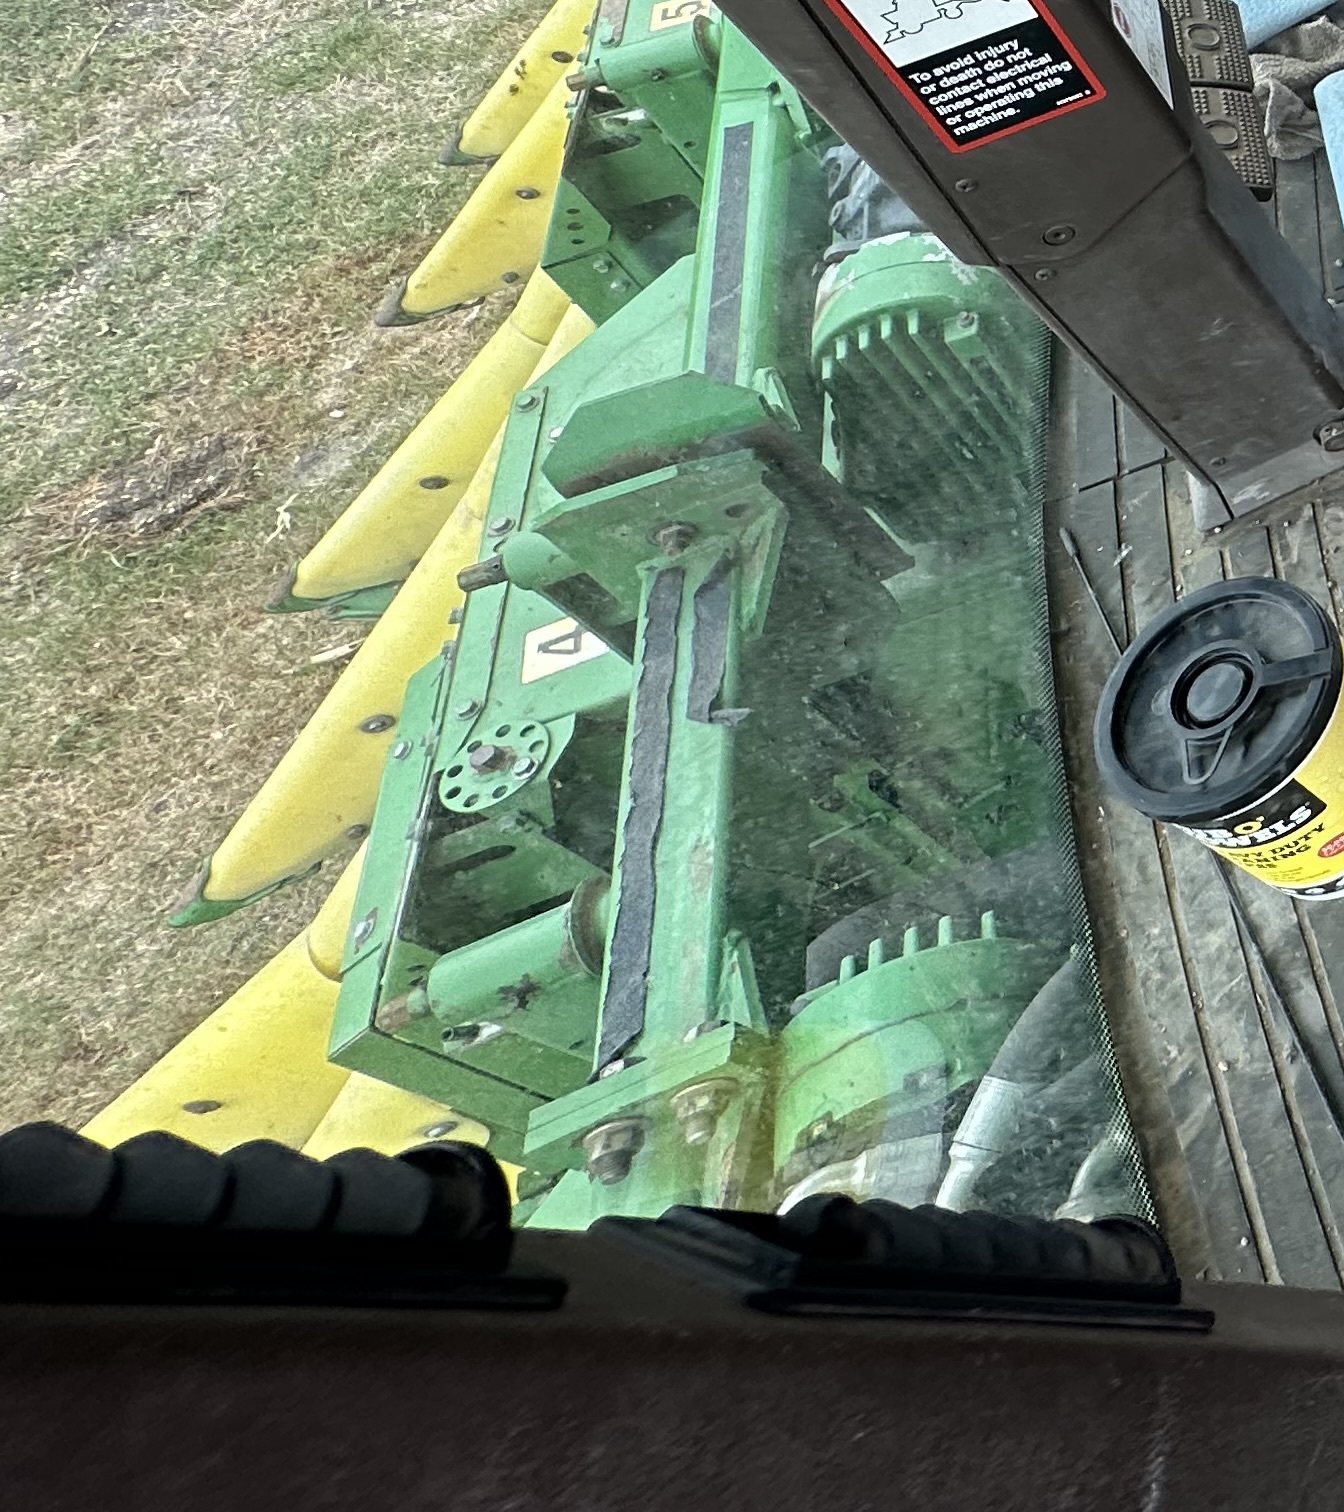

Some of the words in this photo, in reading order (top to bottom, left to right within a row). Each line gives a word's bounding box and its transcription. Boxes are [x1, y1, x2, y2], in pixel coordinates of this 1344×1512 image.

[911, 69, 932, 83] To
[930, 53, 975, 77] avoid
[973, 37, 1022, 62] injury
[920, 82, 939, 94] or
[936, 65, 983, 88] death
[981, 56, 1006, 72] do
[1004, 46, 1033, 63] not
[928, 78, 986, 105] contact
[982, 52, 1054, 84] electrical
[935, 94, 975, 115] lines
[972, 79, 1017, 101] when
[1015, 59, 1073, 87] moving
[944, 113, 963, 125] or
[961, 86, 1036, 120] operating
[1033, 74, 1064, 92] this
[951, 104, 1022, 135] machine.
[537, 624, 587, 655] 4
[1270, 822, 1325, 855] DUTY
